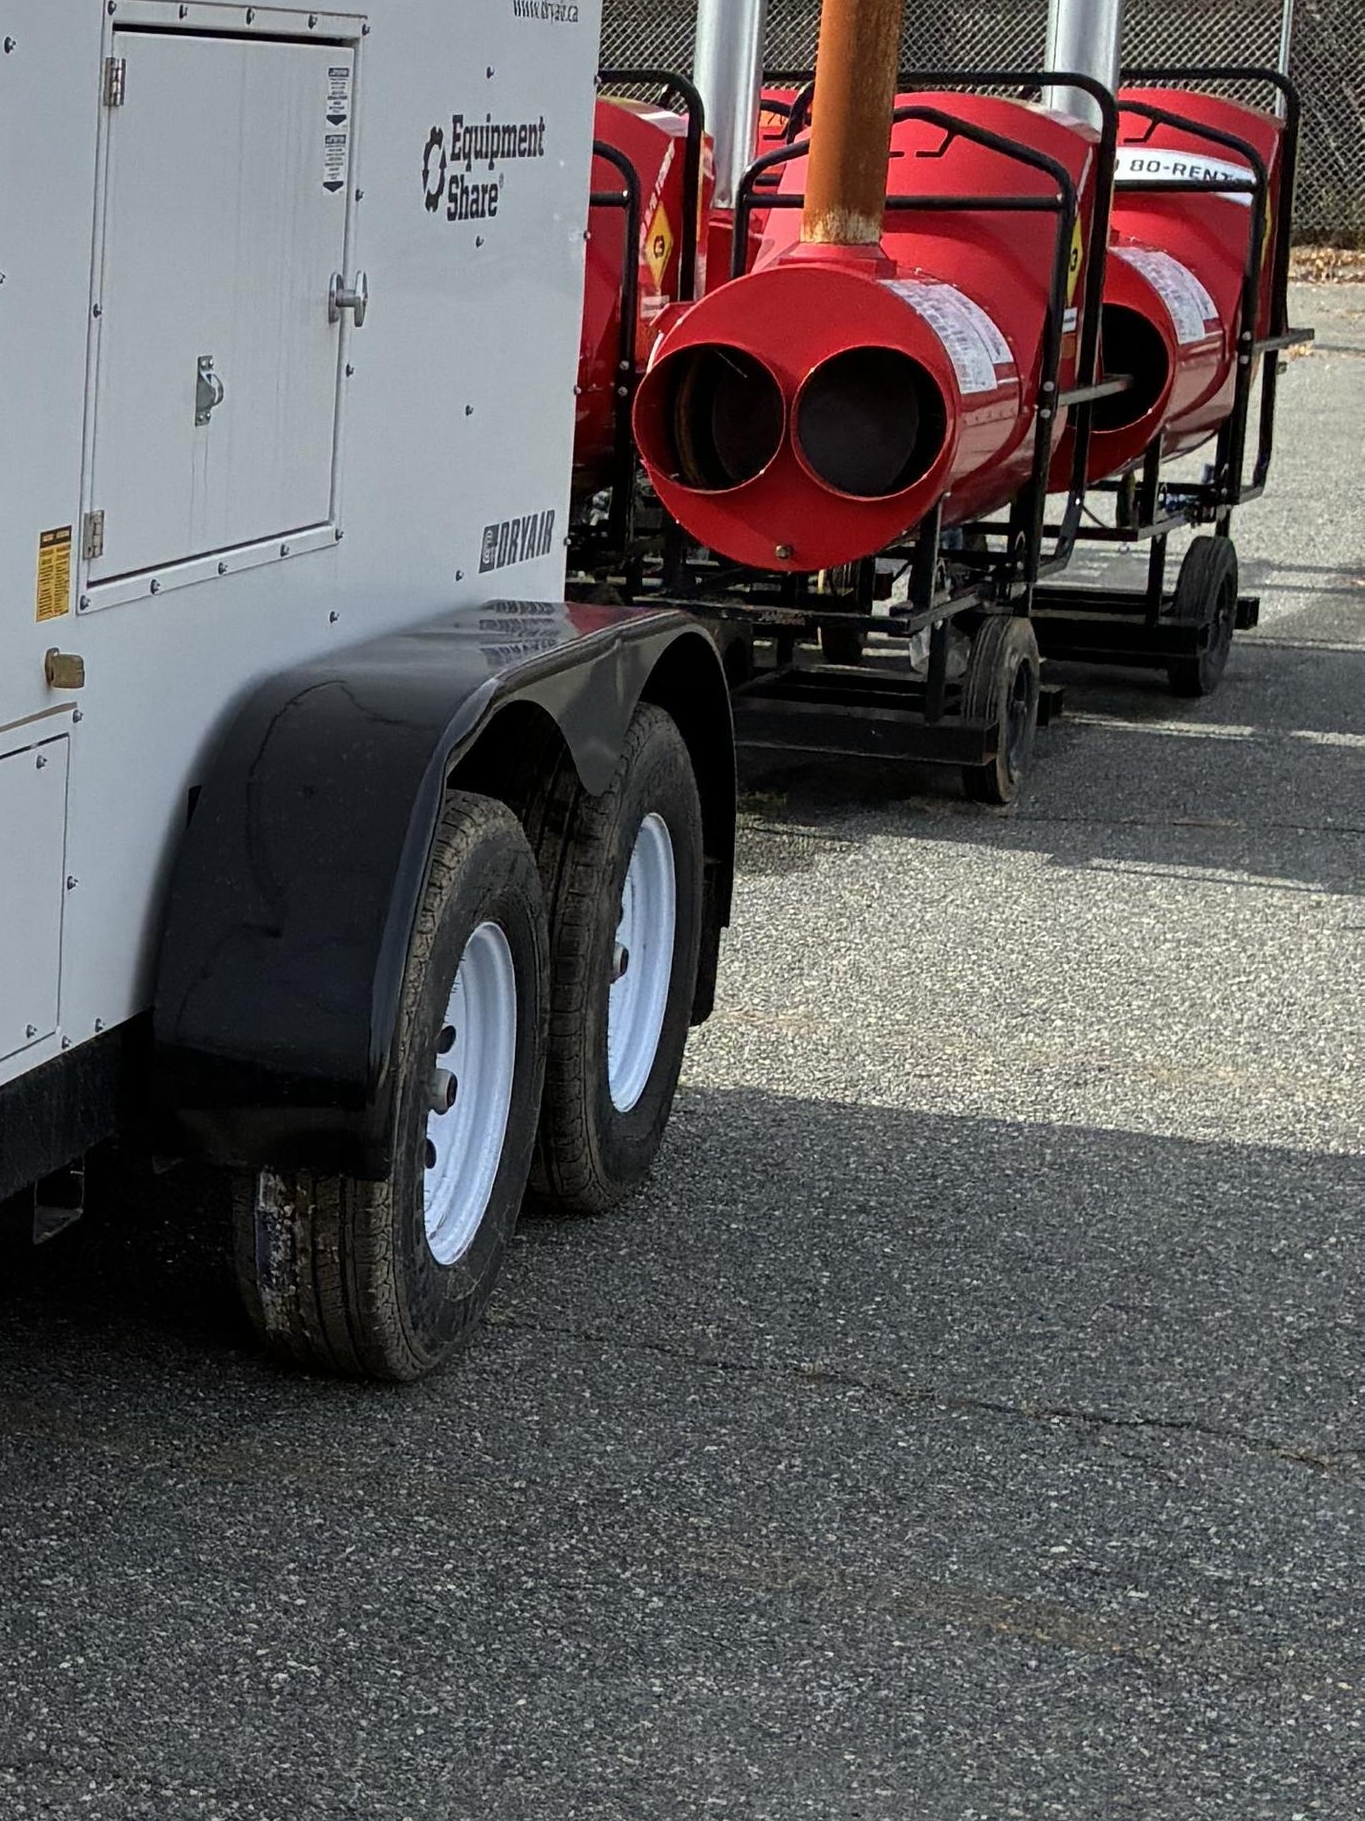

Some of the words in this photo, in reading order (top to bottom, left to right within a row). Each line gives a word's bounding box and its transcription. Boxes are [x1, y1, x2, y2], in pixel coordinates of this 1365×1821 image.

[450, 113, 545, 172] Equipment
[1129, 159, 1250, 181] 80-RENT
[447, 174, 499, 221] Share
[496, 509, 555, 569] DRYAIR
